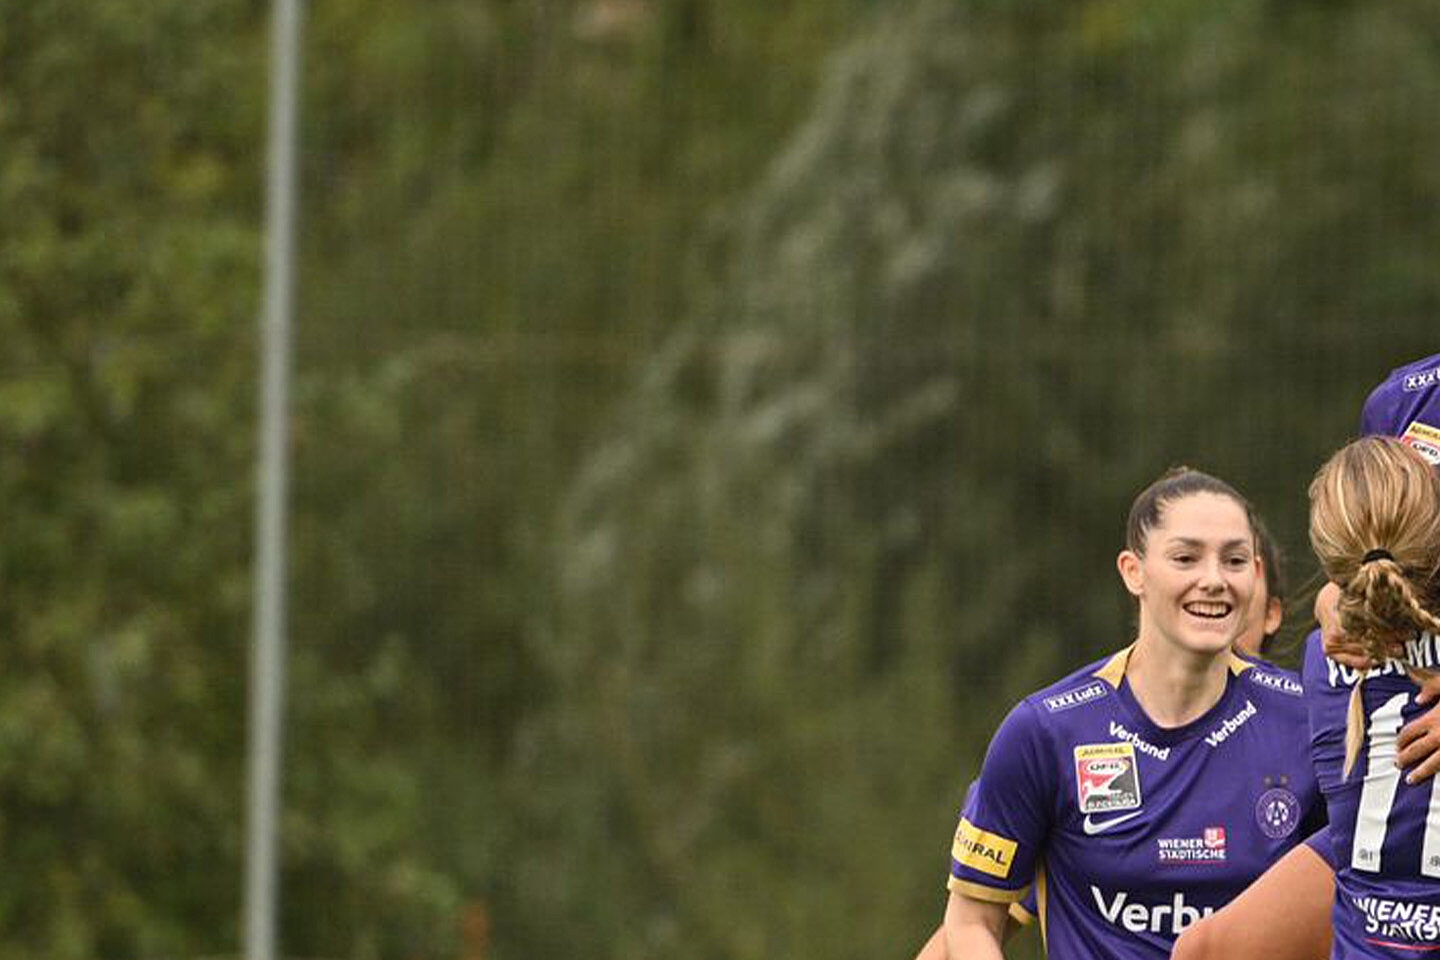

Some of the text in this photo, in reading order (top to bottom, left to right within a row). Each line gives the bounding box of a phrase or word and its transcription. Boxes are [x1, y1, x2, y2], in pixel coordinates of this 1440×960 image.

[1108, 721, 1171, 762] Verbund
[1204, 700, 1257, 747] Verbund
[1157, 837, 1204, 849] WIENER
[1090, 885, 1215, 935] Verb
